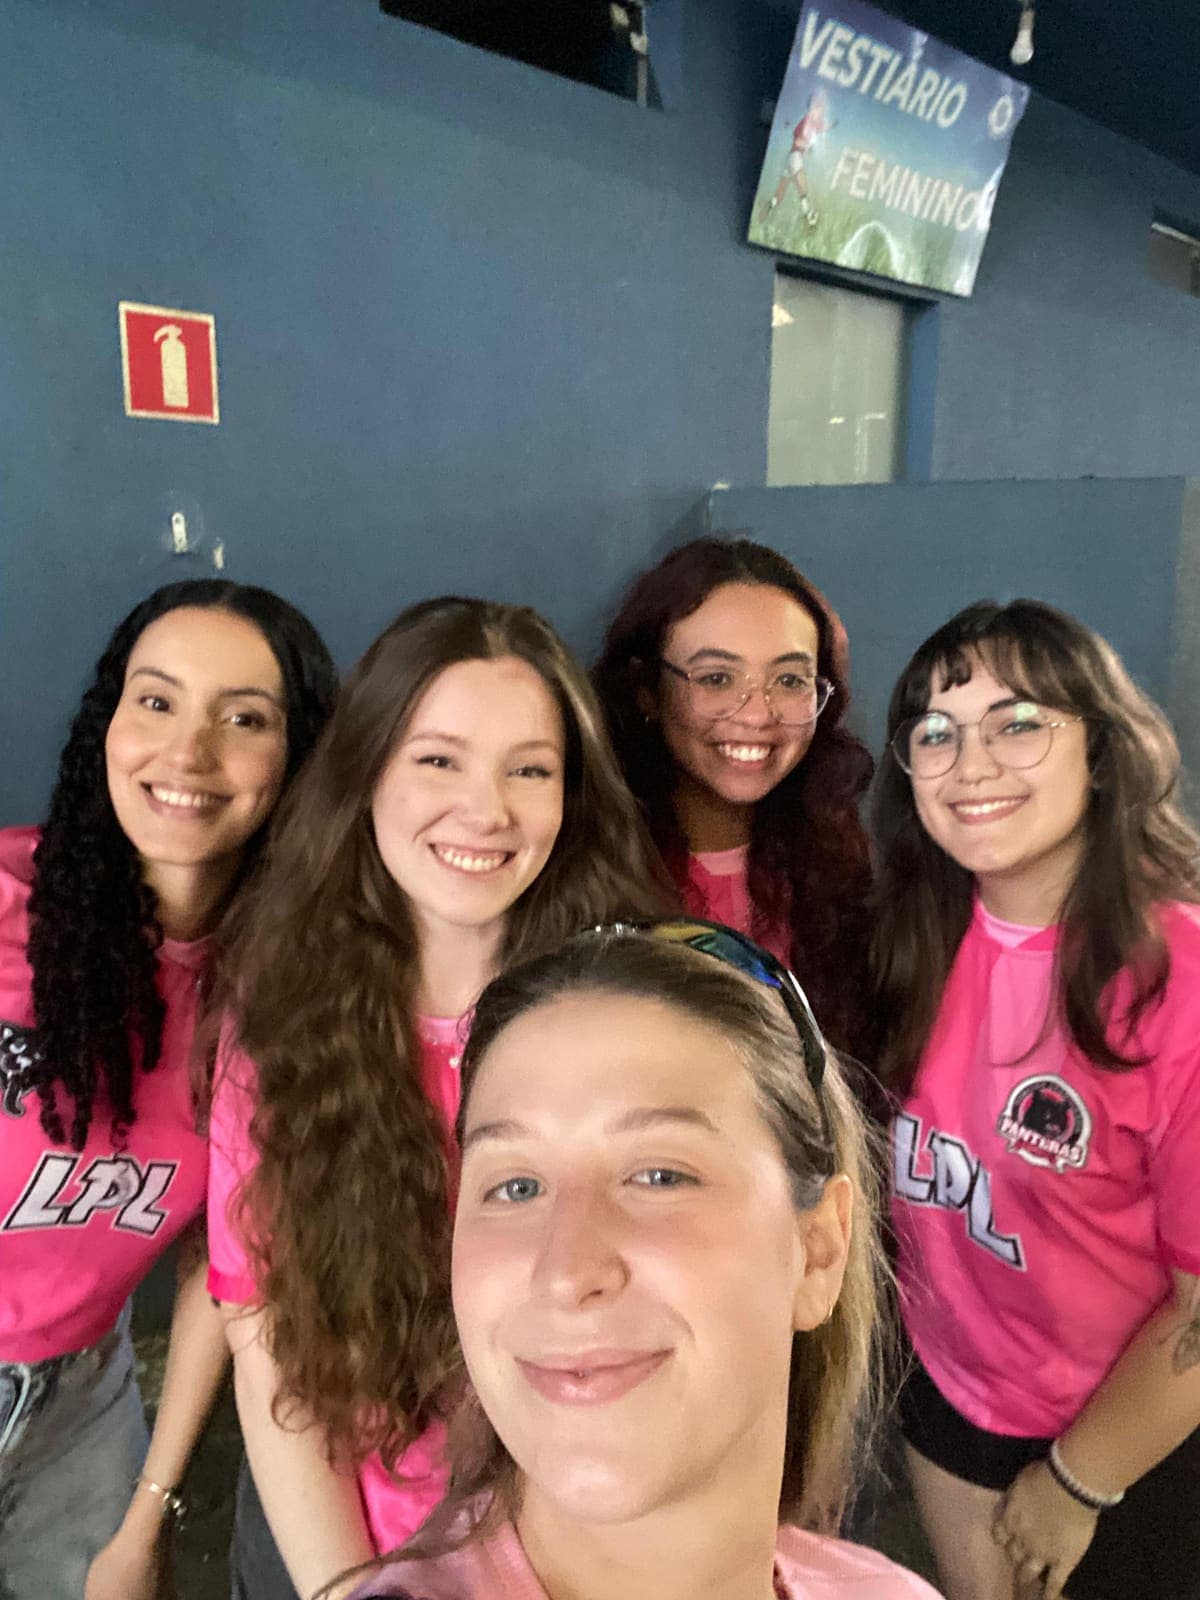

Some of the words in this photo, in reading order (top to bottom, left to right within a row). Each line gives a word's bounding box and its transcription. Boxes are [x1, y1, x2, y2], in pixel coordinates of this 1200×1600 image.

[800, 10, 968, 128] VESTIÁRIO
[830, 147, 980, 232] FEMININO
[1, 1150, 180, 1238] LPL
[893, 1113, 1026, 1270] LPL
